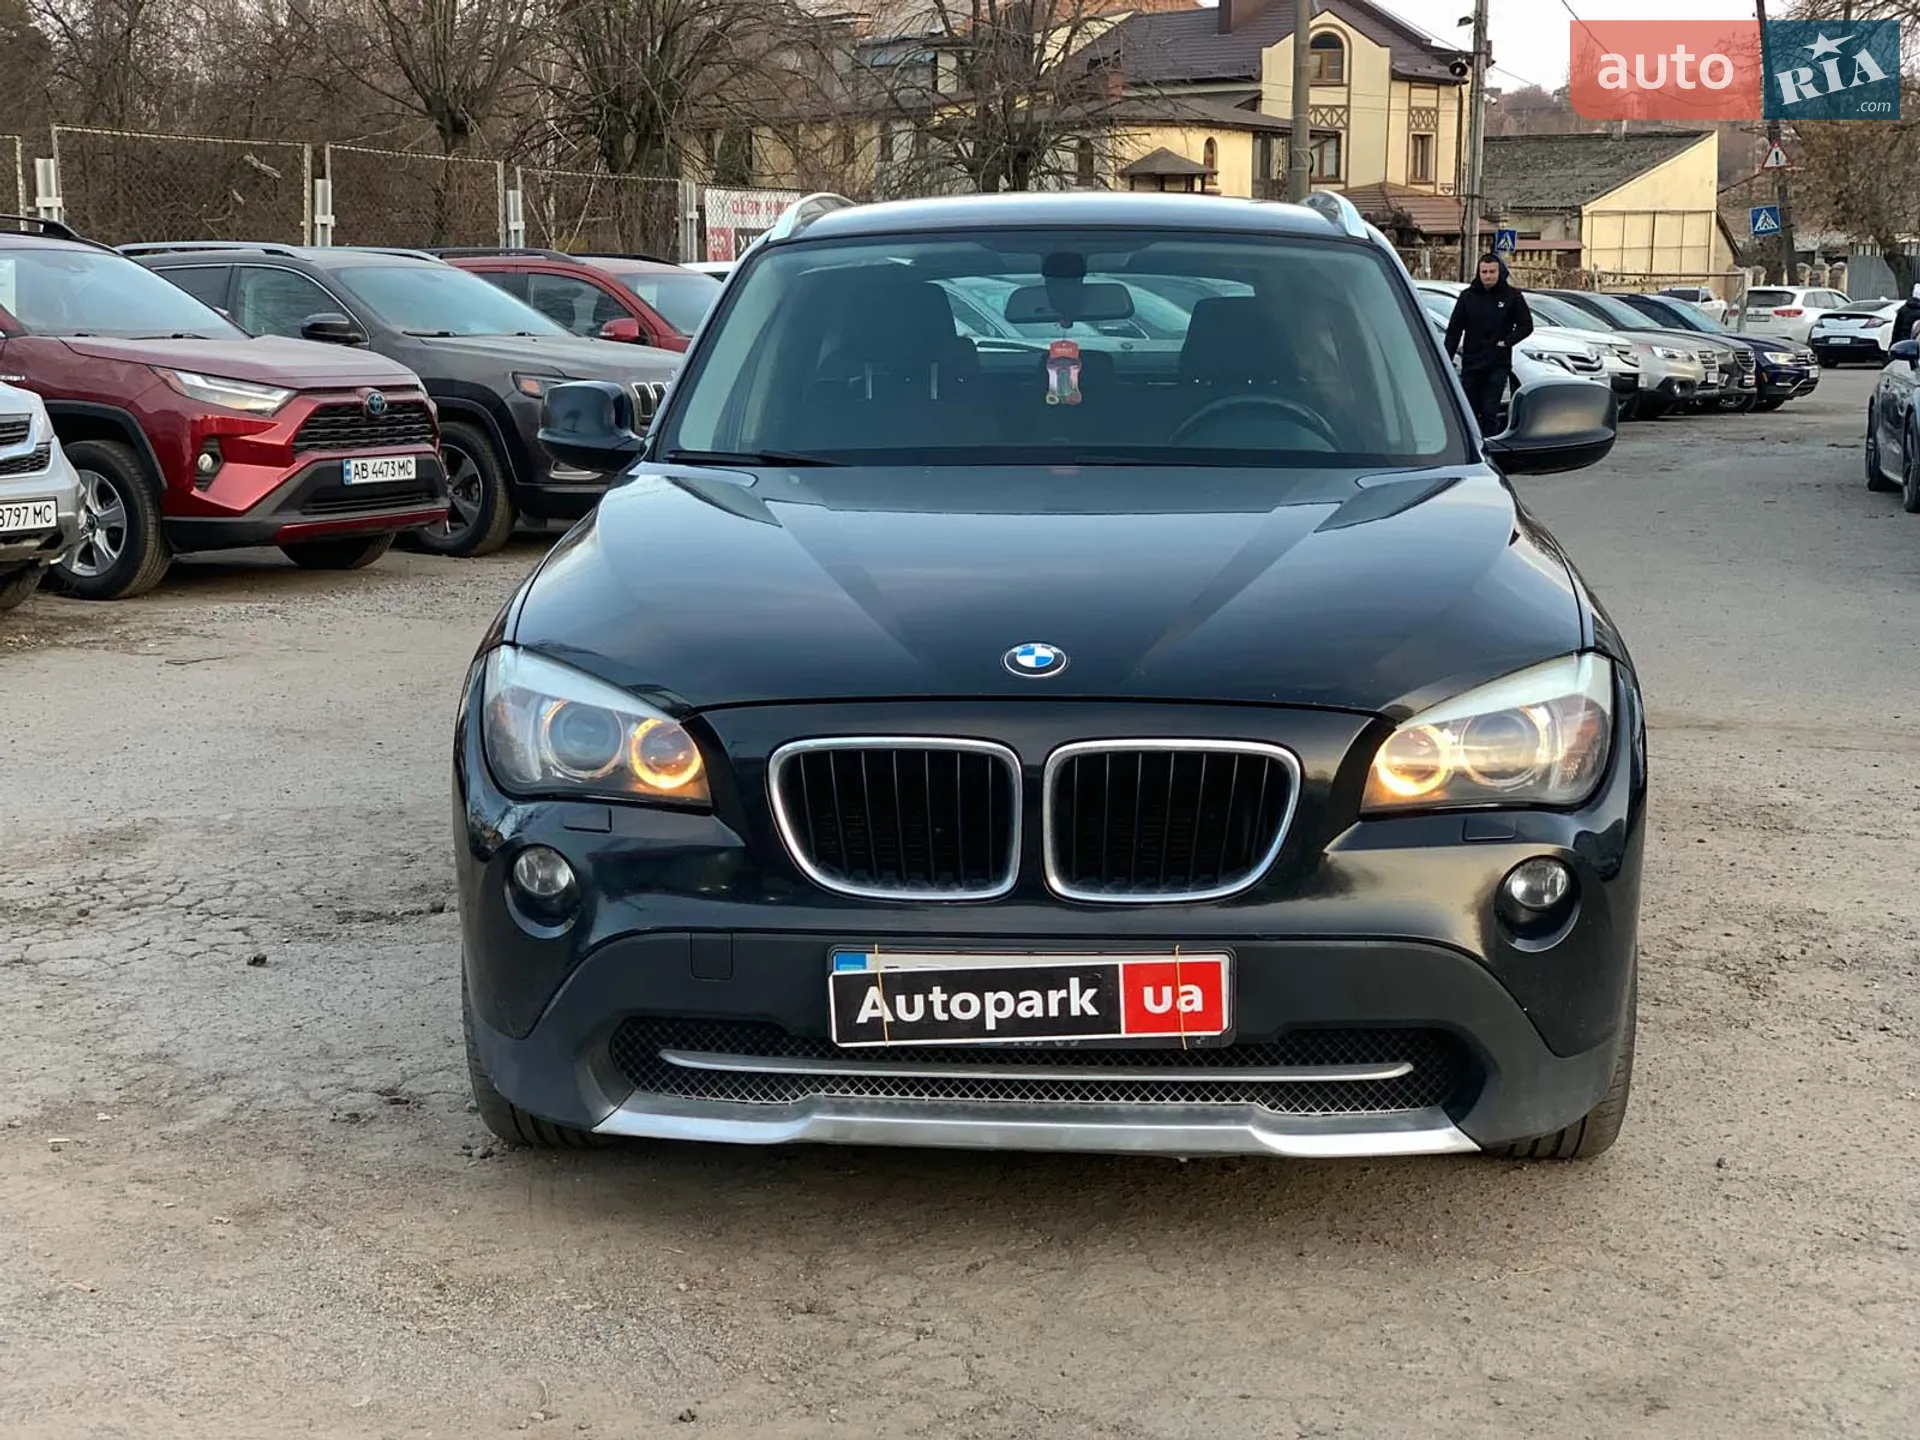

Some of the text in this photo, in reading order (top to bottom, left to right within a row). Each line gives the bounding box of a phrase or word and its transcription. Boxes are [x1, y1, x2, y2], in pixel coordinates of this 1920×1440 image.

[354, 459, 413, 479] AB 4473 MC
[33, 504, 52, 525] MC
[856, 977, 1204, 1030] Autopark ua
